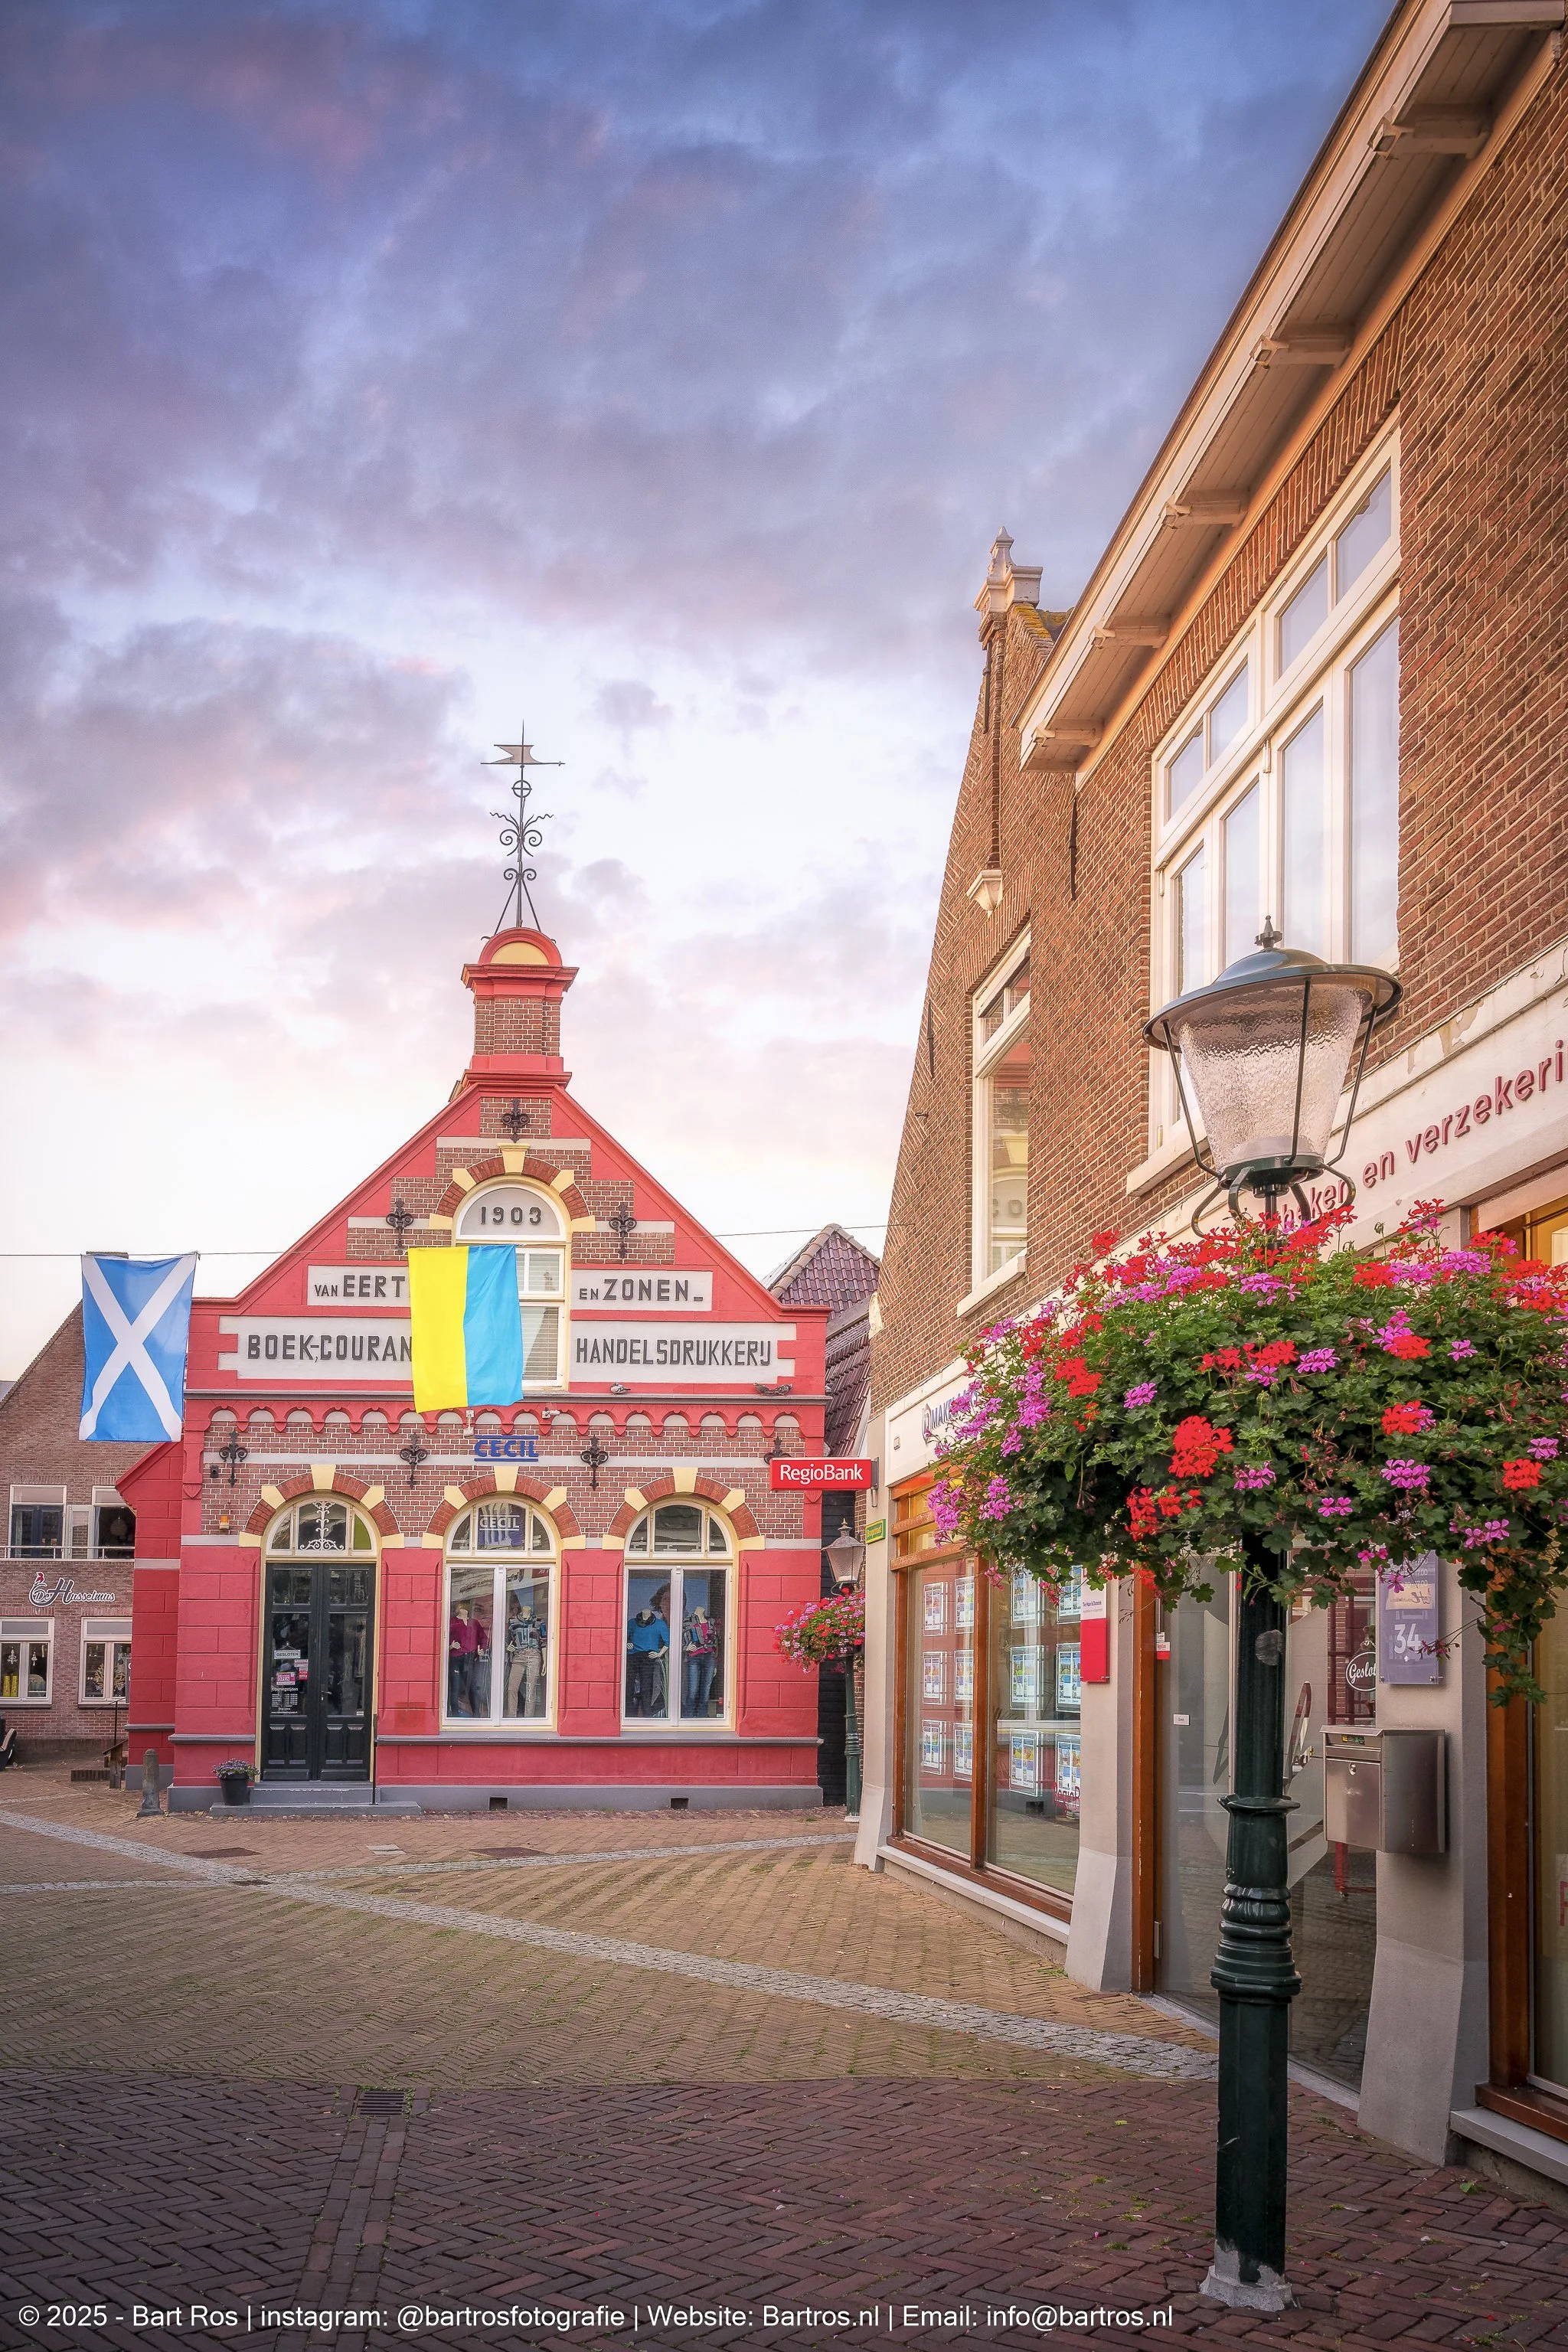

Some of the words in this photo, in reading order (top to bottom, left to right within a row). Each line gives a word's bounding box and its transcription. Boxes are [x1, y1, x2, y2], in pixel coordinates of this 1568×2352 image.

[1362, 1151, 1395, 1188] en
[1405, 1040, 1568, 1164] verzekeri
[480, 1205, 542, 1226] 1903
[315, 1285, 338, 1297] VAN
[343, 1275, 410, 1298] EERT
[579, 1288, 599, 1300] EN
[576, 1338, 771, 1366] HANDELSDRUKKERIJ
[474, 1439, 540, 1458] CECIL
[779, 1463, 864, 1486] RegioBank
[479, 1517, 520, 1529] CECIL
[1393, 1623, 1422, 1655] 34
